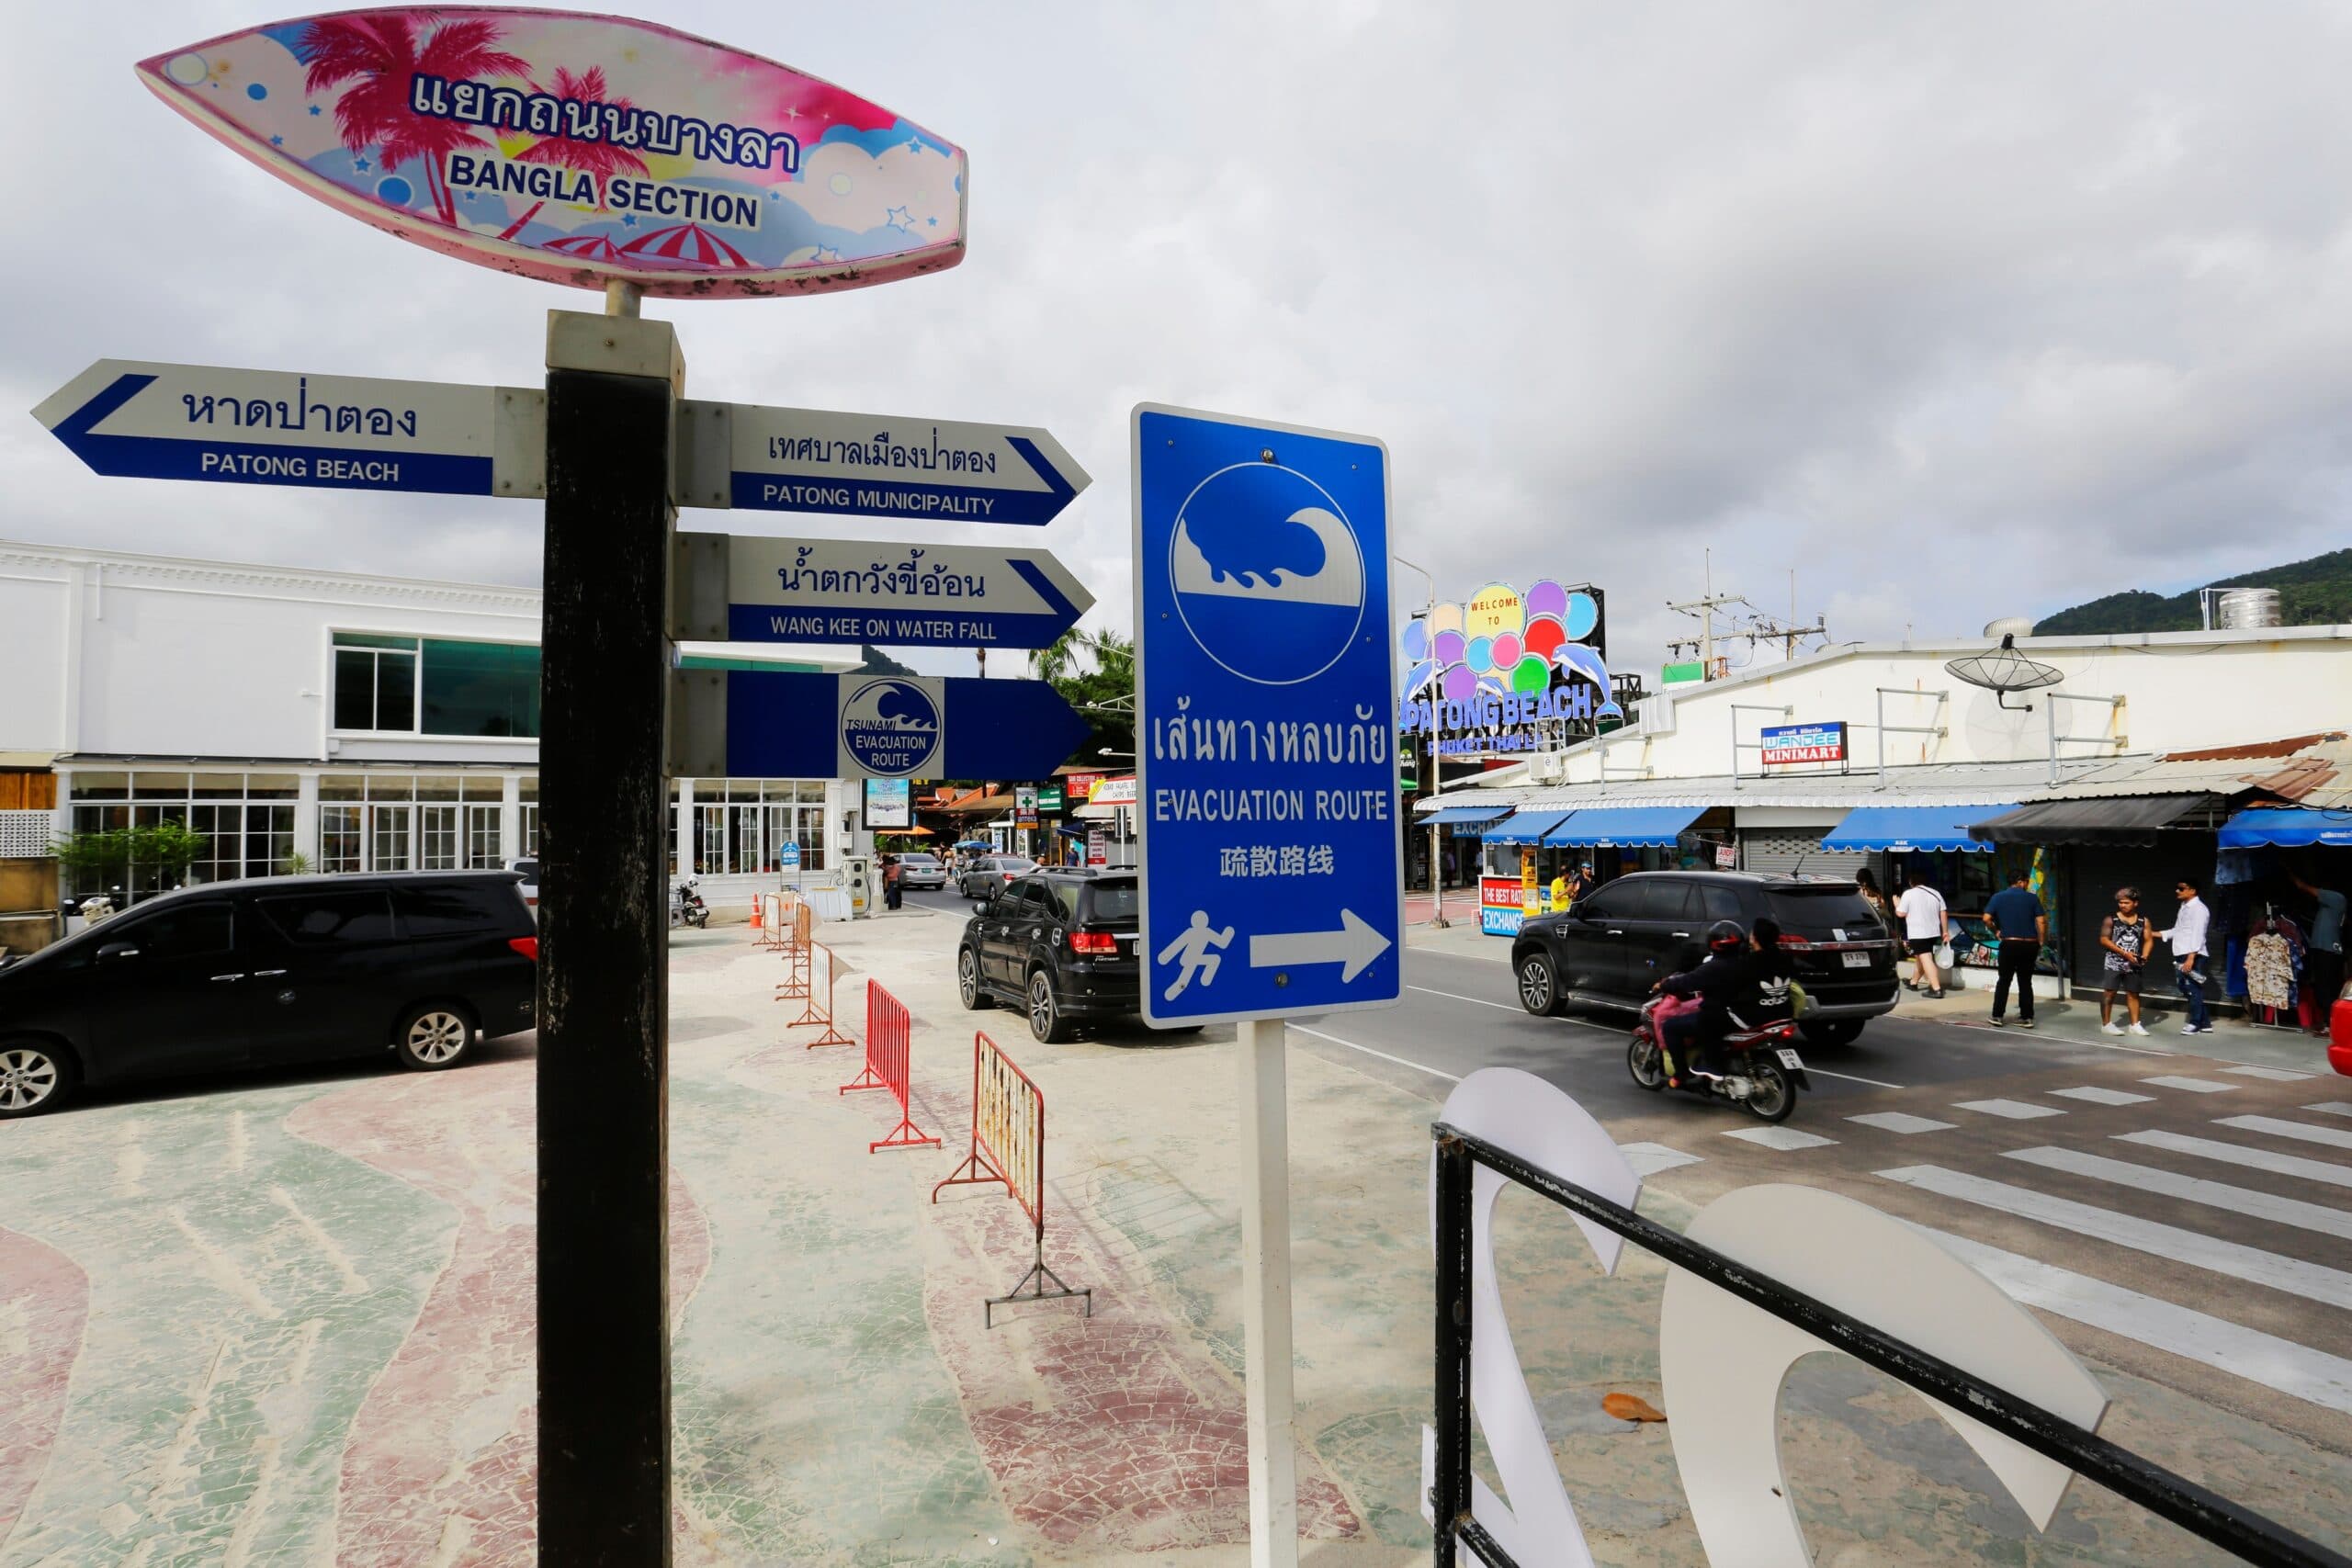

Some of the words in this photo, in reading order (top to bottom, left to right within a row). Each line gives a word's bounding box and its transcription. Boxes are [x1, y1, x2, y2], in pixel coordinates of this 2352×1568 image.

[412, 73, 800, 173] แยกถนนบางลา
[449, 155, 597, 205] BANGLA
[609, 178, 759, 228] SECTION
[183, 378, 417, 437] หาดป่าตอง
[769, 427, 997, 474] เทศบาลเมืองป่าตอง
[201, 453, 308, 478] PATONG
[316, 459, 400, 483] BEACH
[763, 484, 850, 507] PATONG
[856, 490, 995, 515] MUNICIPALITY
[777, 547, 987, 598] น้ำตกวังขี้อ้อน
[1471, 597, 1518, 612] WELCOME
[770, 616, 824, 636] WANG
[830, 617, 861, 637] KEE
[866, 619, 890, 637] ON
[896, 620, 954, 639] WATER
[959, 622, 997, 640] FALL
[1487, 615, 1499, 626] TO
[1404, 696, 1498, 735] PATONG
[1502, 684, 1592, 725] BEACH
[846, 719, 897, 731] TSUNAMI
[1154, 695, 1386, 764] เส้นทางหลบภัย
[855, 735, 927, 750] EVACUATION
[1427, 736, 1484, 757] PHUKET
[1764, 733, 1839, 750] WANDEE
[1765, 746, 1839, 762] MINIMART
[871, 753, 910, 767] ROUTE
[1155, 789, 1304, 821] EVACUATION
[1316, 790, 1388, 820] ROUTE
[1219, 844, 1335, 877] 疏散路线
[1484, 888, 1495, 902] THE
[1496, 888, 1510, 903] BEST
